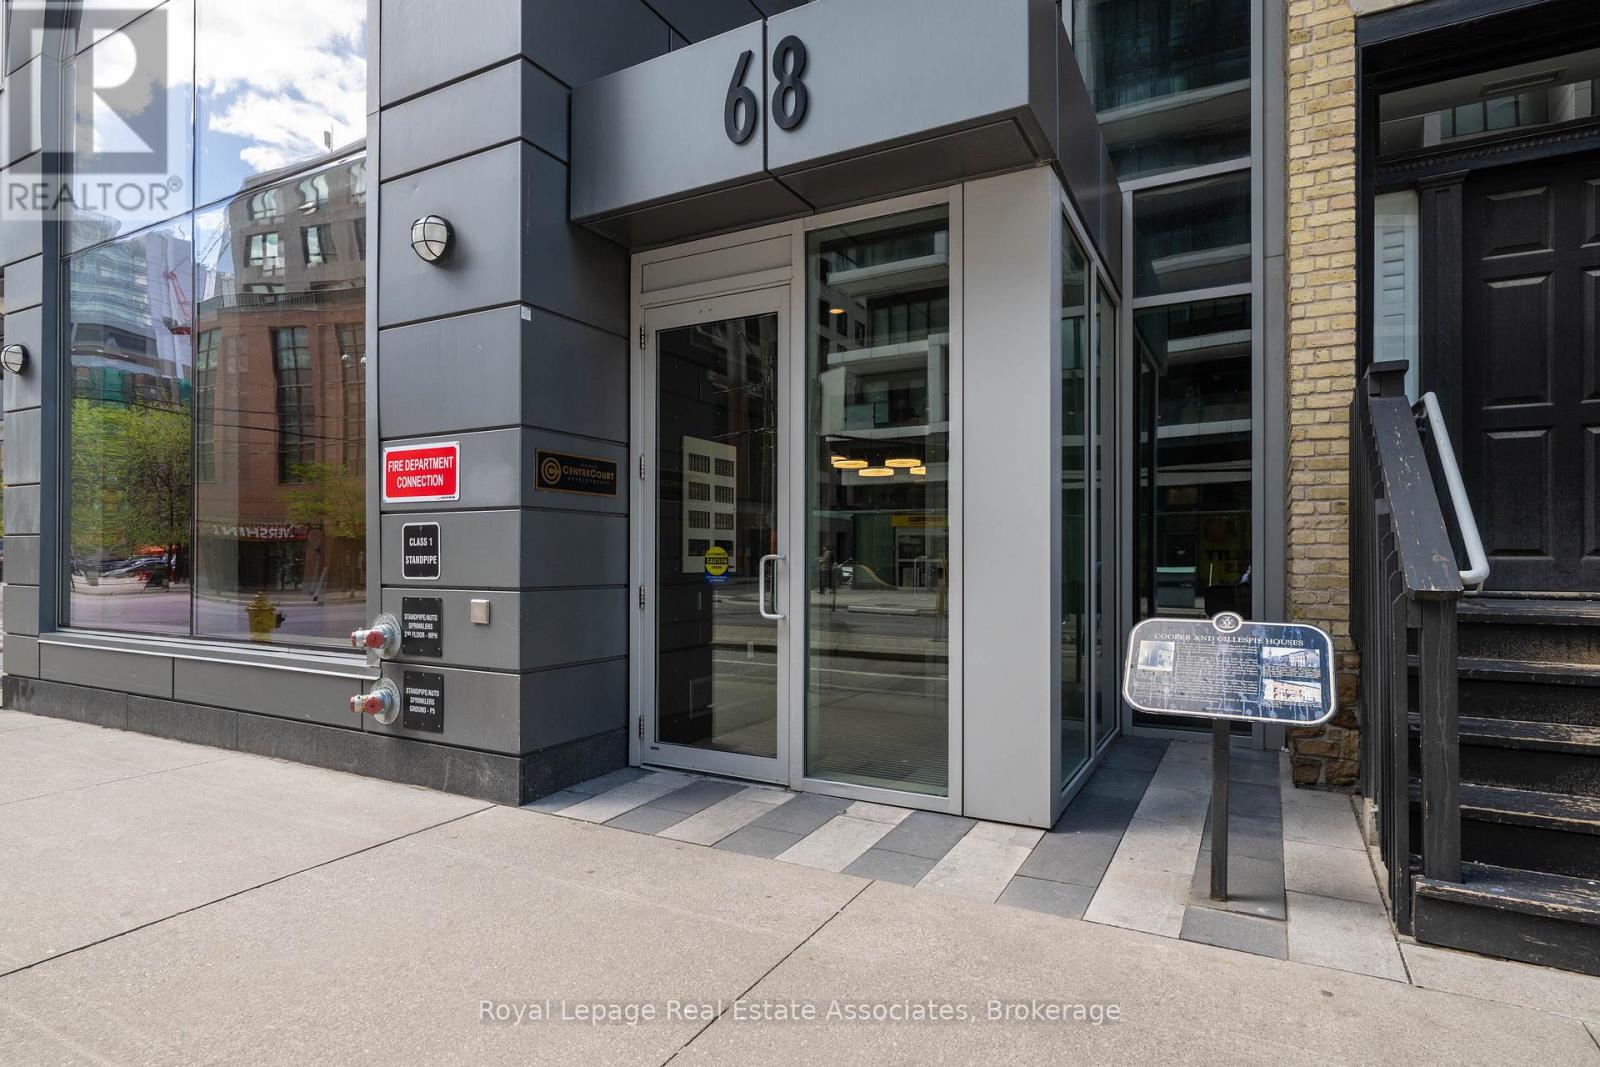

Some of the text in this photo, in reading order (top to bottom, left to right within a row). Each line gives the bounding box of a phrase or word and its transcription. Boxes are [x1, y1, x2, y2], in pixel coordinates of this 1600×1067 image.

[724, 35, 808, 145] 68
[388, 456, 454, 472] FIRE DEPARTMENT
[396, 474, 443, 488] CONNECTION
[409, 537, 433, 547] CLASS 1
[405, 555, 437, 565] STANDPIPE
[408, 622, 433, 630] SPRINKLERS
[412, 631, 425, 639] FLOOR
[1154, 633, 1191, 641] COOPER
[1217, 636, 1263, 644] GILLESPIE
[1265, 638, 1304, 646] HOUSES
[409, 696, 435, 705] SPRINKLERS
[409, 705, 427, 713] GROUND
